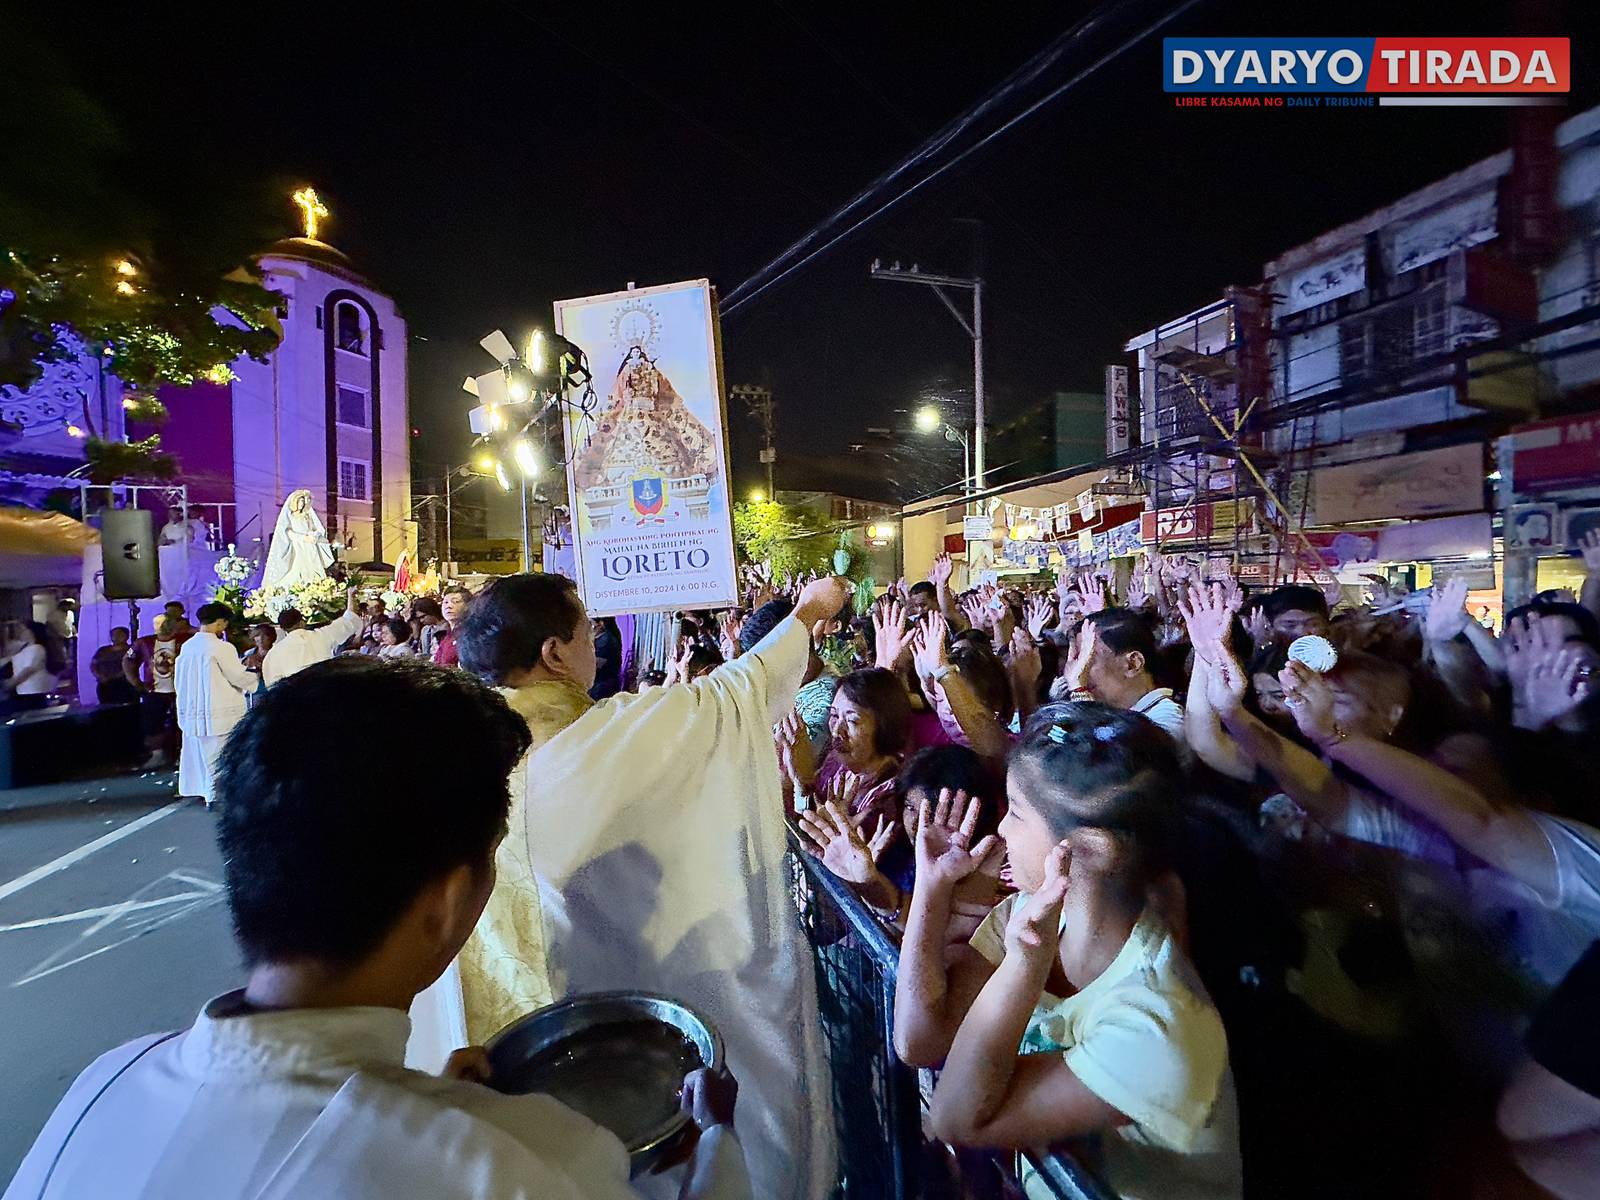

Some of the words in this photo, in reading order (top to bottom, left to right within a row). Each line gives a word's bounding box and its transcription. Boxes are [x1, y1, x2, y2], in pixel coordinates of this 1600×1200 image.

[637, 543, 649, 552] NA
[689, 538, 703, 547] NG
[601, 548, 710, 581] LORETO
[654, 585, 675, 594] 2024
